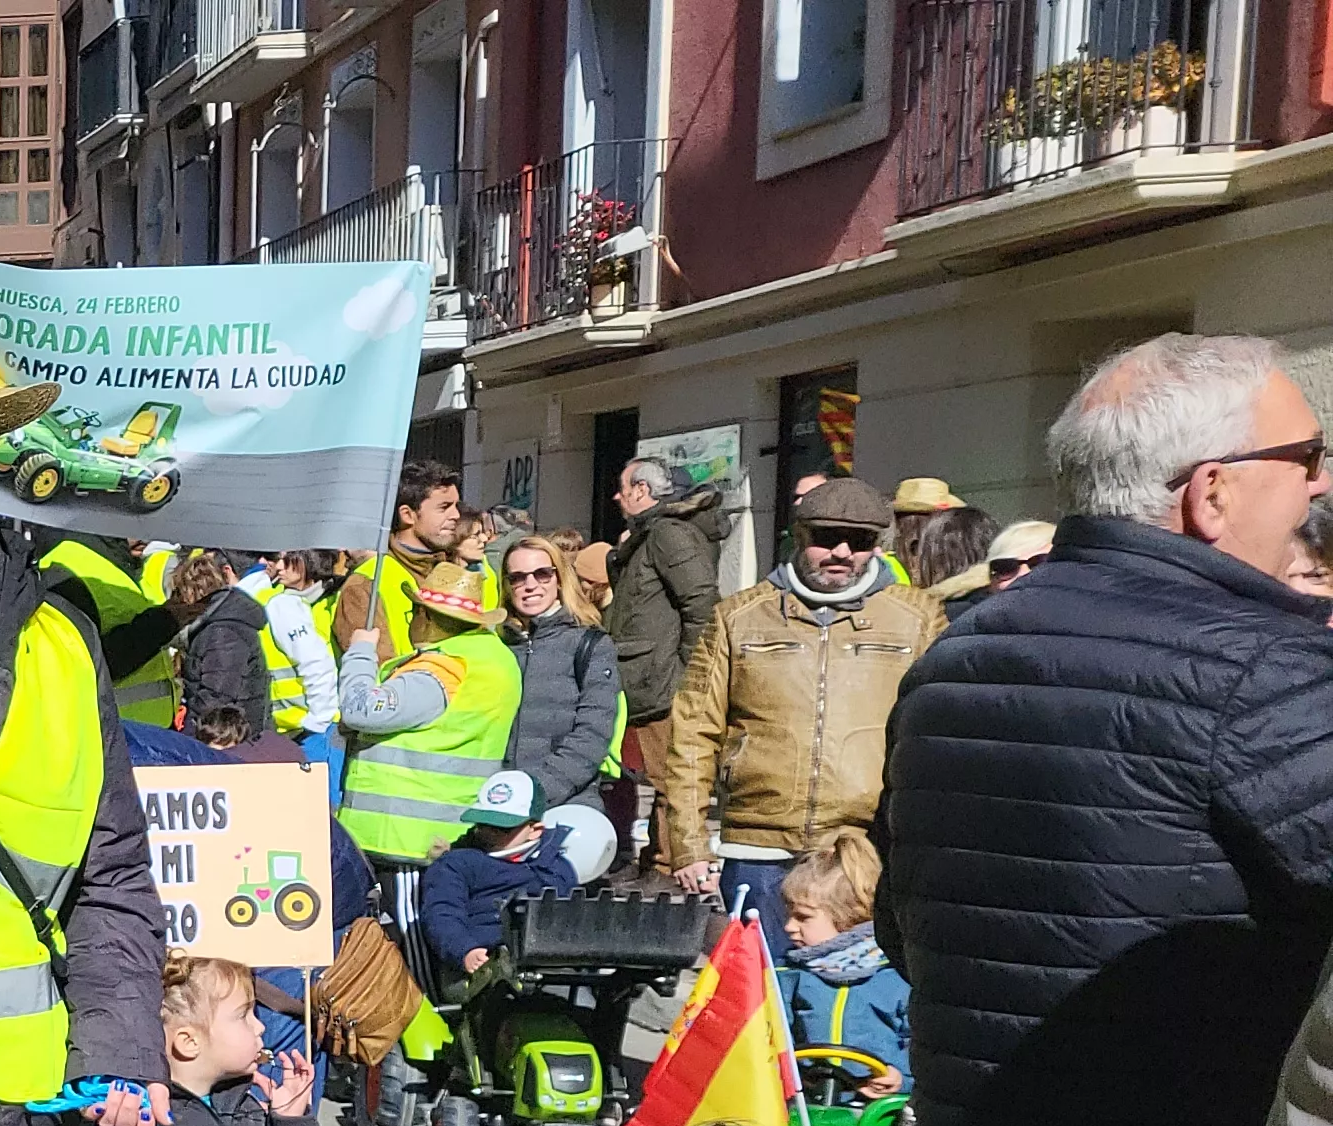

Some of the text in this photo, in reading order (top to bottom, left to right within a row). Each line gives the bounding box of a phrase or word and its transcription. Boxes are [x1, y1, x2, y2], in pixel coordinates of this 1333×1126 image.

[76, 297, 97, 314] 24
[104, 295, 180, 314] FEBRERO
[125, 322, 277, 356] INFANTIL
[4, 351, 87, 385] CAMPO
[95, 366, 221, 389] ALIMENTA
[231, 366, 258, 389] LA
[267, 363, 347, 388] CIUDAD
[287, 625, 309, 642] HH
[144, 791, 229, 831] AMOS
[161, 844, 195, 884] MI
[163, 903, 199, 943] RO
